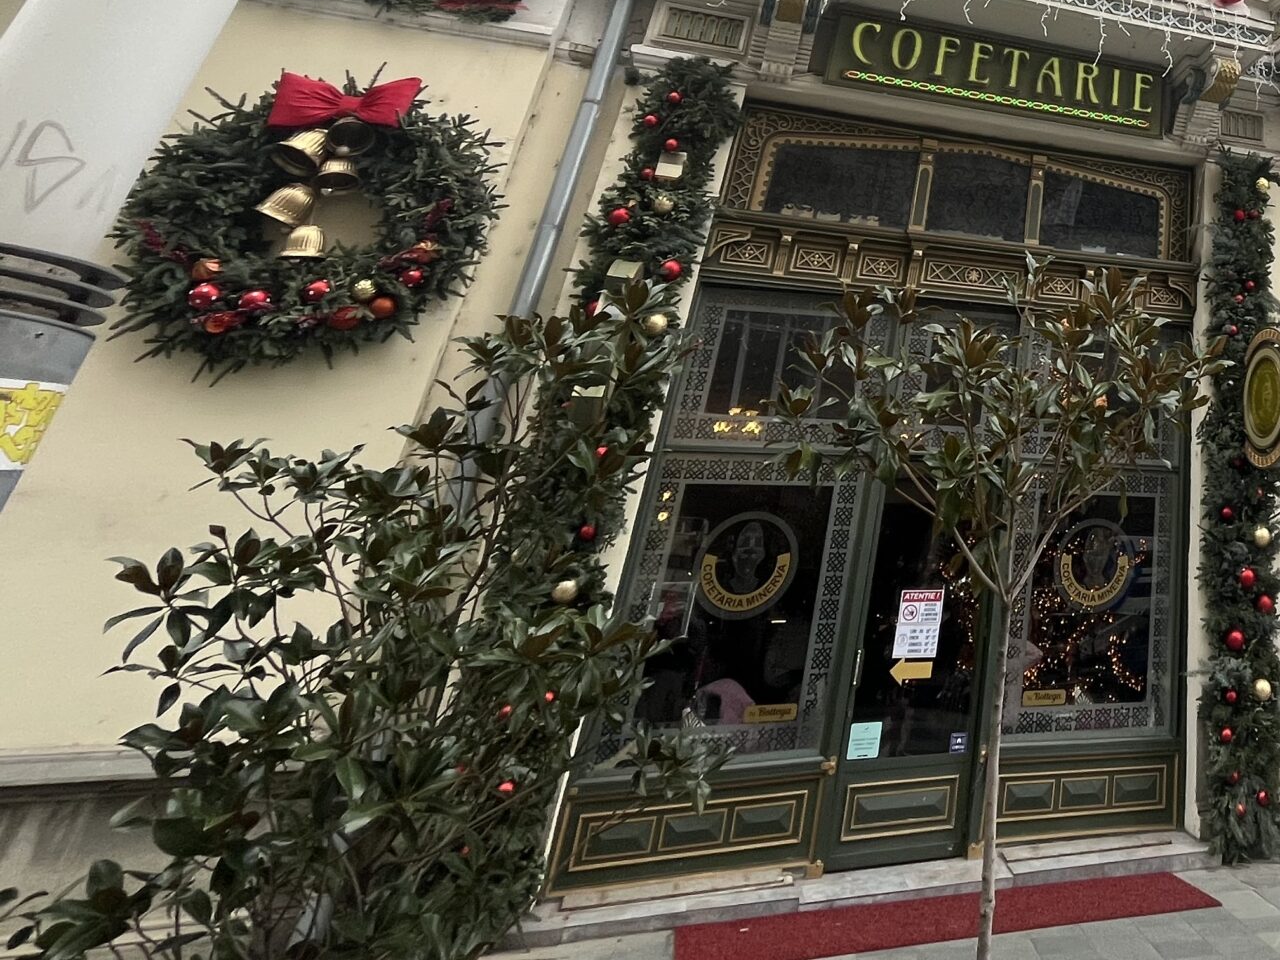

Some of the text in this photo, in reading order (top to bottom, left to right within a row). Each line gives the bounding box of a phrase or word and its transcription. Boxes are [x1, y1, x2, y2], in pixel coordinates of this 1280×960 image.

[851, 21, 1154, 113] COFETARIE
[703, 564, 786, 608] COFETARIA MINERVA
[1062, 563, 1126, 602] COFETARIA MINERVA
